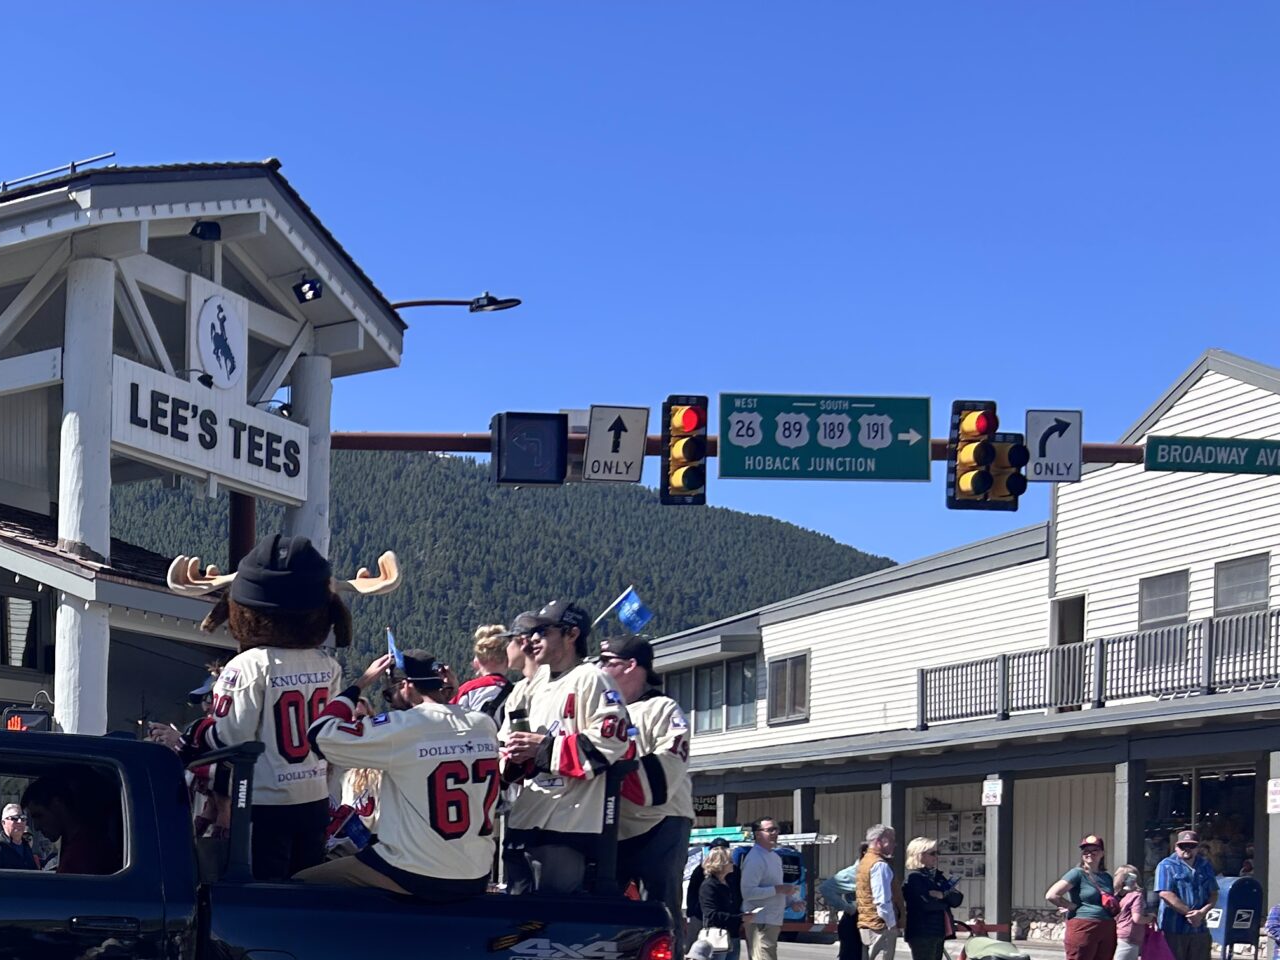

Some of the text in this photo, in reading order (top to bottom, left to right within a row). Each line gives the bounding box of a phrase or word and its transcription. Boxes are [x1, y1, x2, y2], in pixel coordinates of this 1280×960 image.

[734, 398, 849, 411] WEST SOUTH
[130, 382, 301, 478] LEE'S TEES
[735, 419, 885, 441] 26 89 189 191
[745, 456, 876, 472] HOBACK JUNCTION
[1156, 444, 1249, 465] BROADWAY
[591, 459, 634, 475] ONLY
[1033, 461, 1073, 476] ONLY
[271, 671, 333, 688] KNUCKLES
[563, 692, 576, 718] A
[419, 743, 465, 757] DOLLY'S
[237, 779, 248, 808] THULE
[427, 758, 500, 841] 67
[605, 795, 616, 825] THULE
